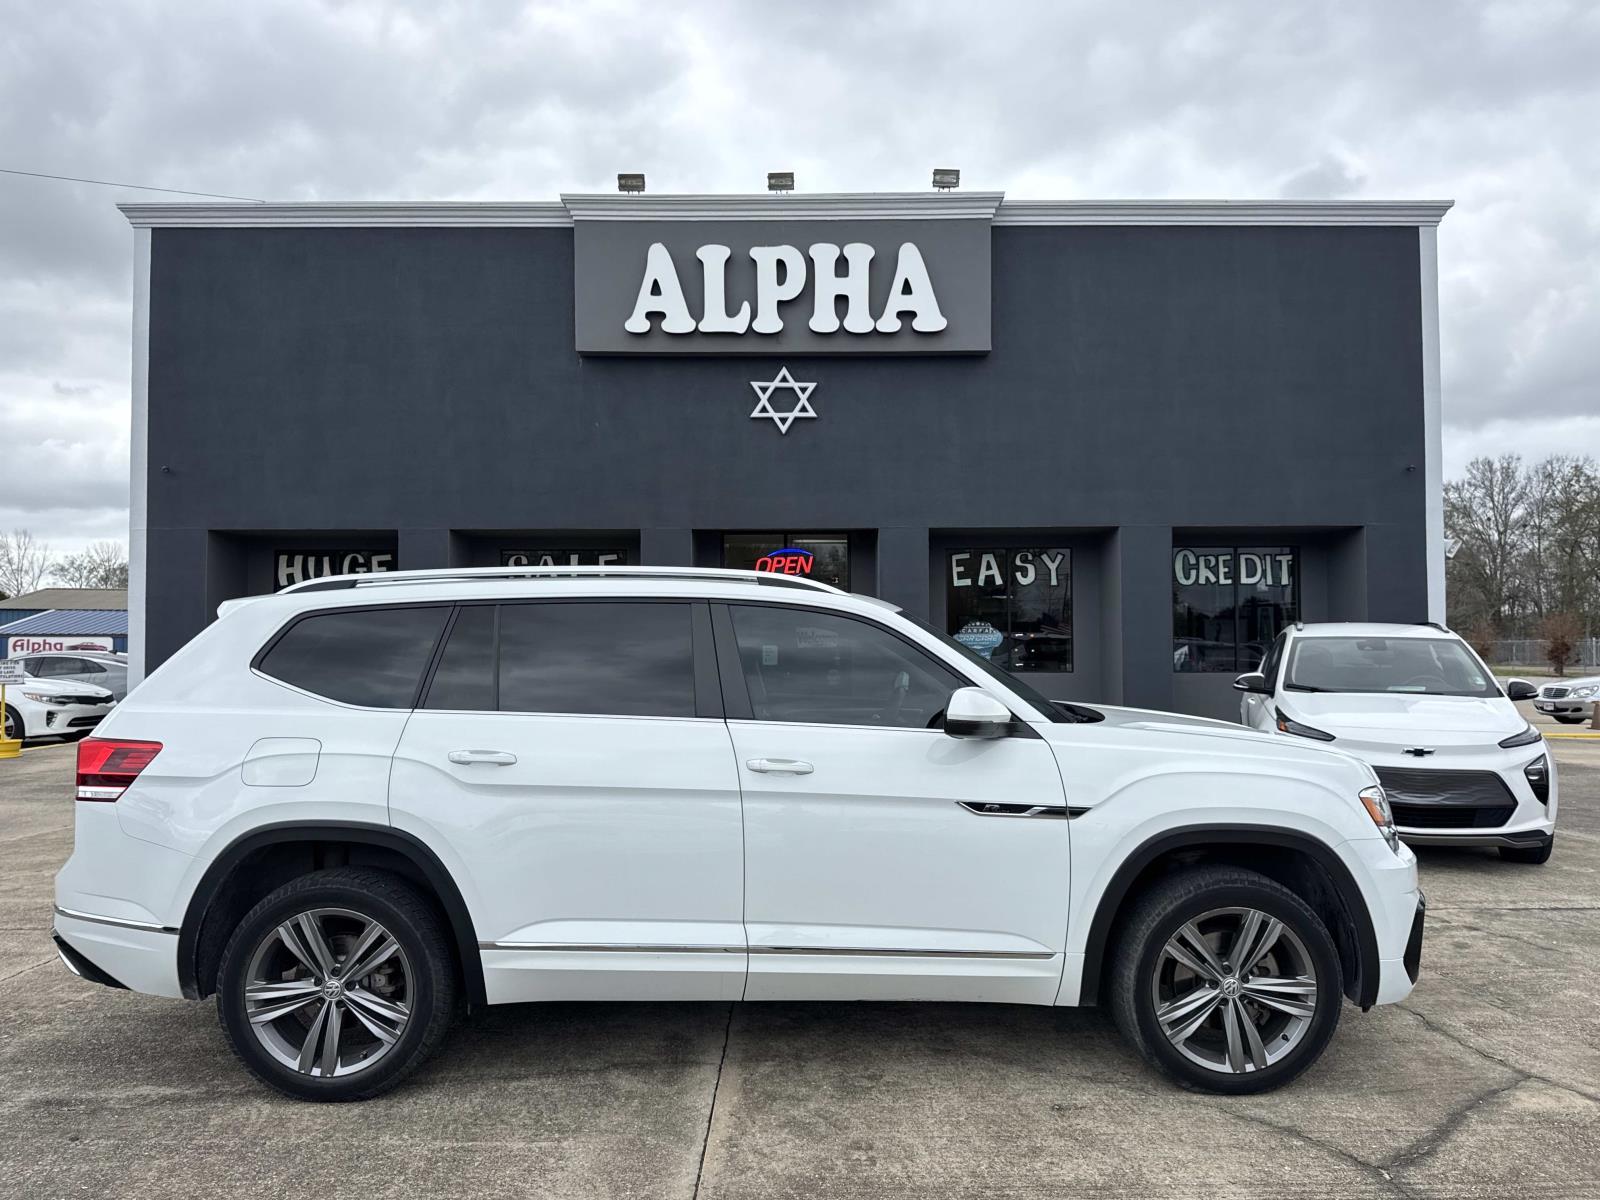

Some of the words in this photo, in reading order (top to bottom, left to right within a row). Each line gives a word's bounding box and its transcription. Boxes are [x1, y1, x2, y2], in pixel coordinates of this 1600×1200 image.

[624, 242, 948, 334] ALPHA
[278, 553, 392, 586] HUGE
[755, 555, 814, 574] OPEN
[951, 552, 1064, 587] EASY
[1174, 549, 1293, 586] CREDIT
[12, 638, 64, 653] Alpha
